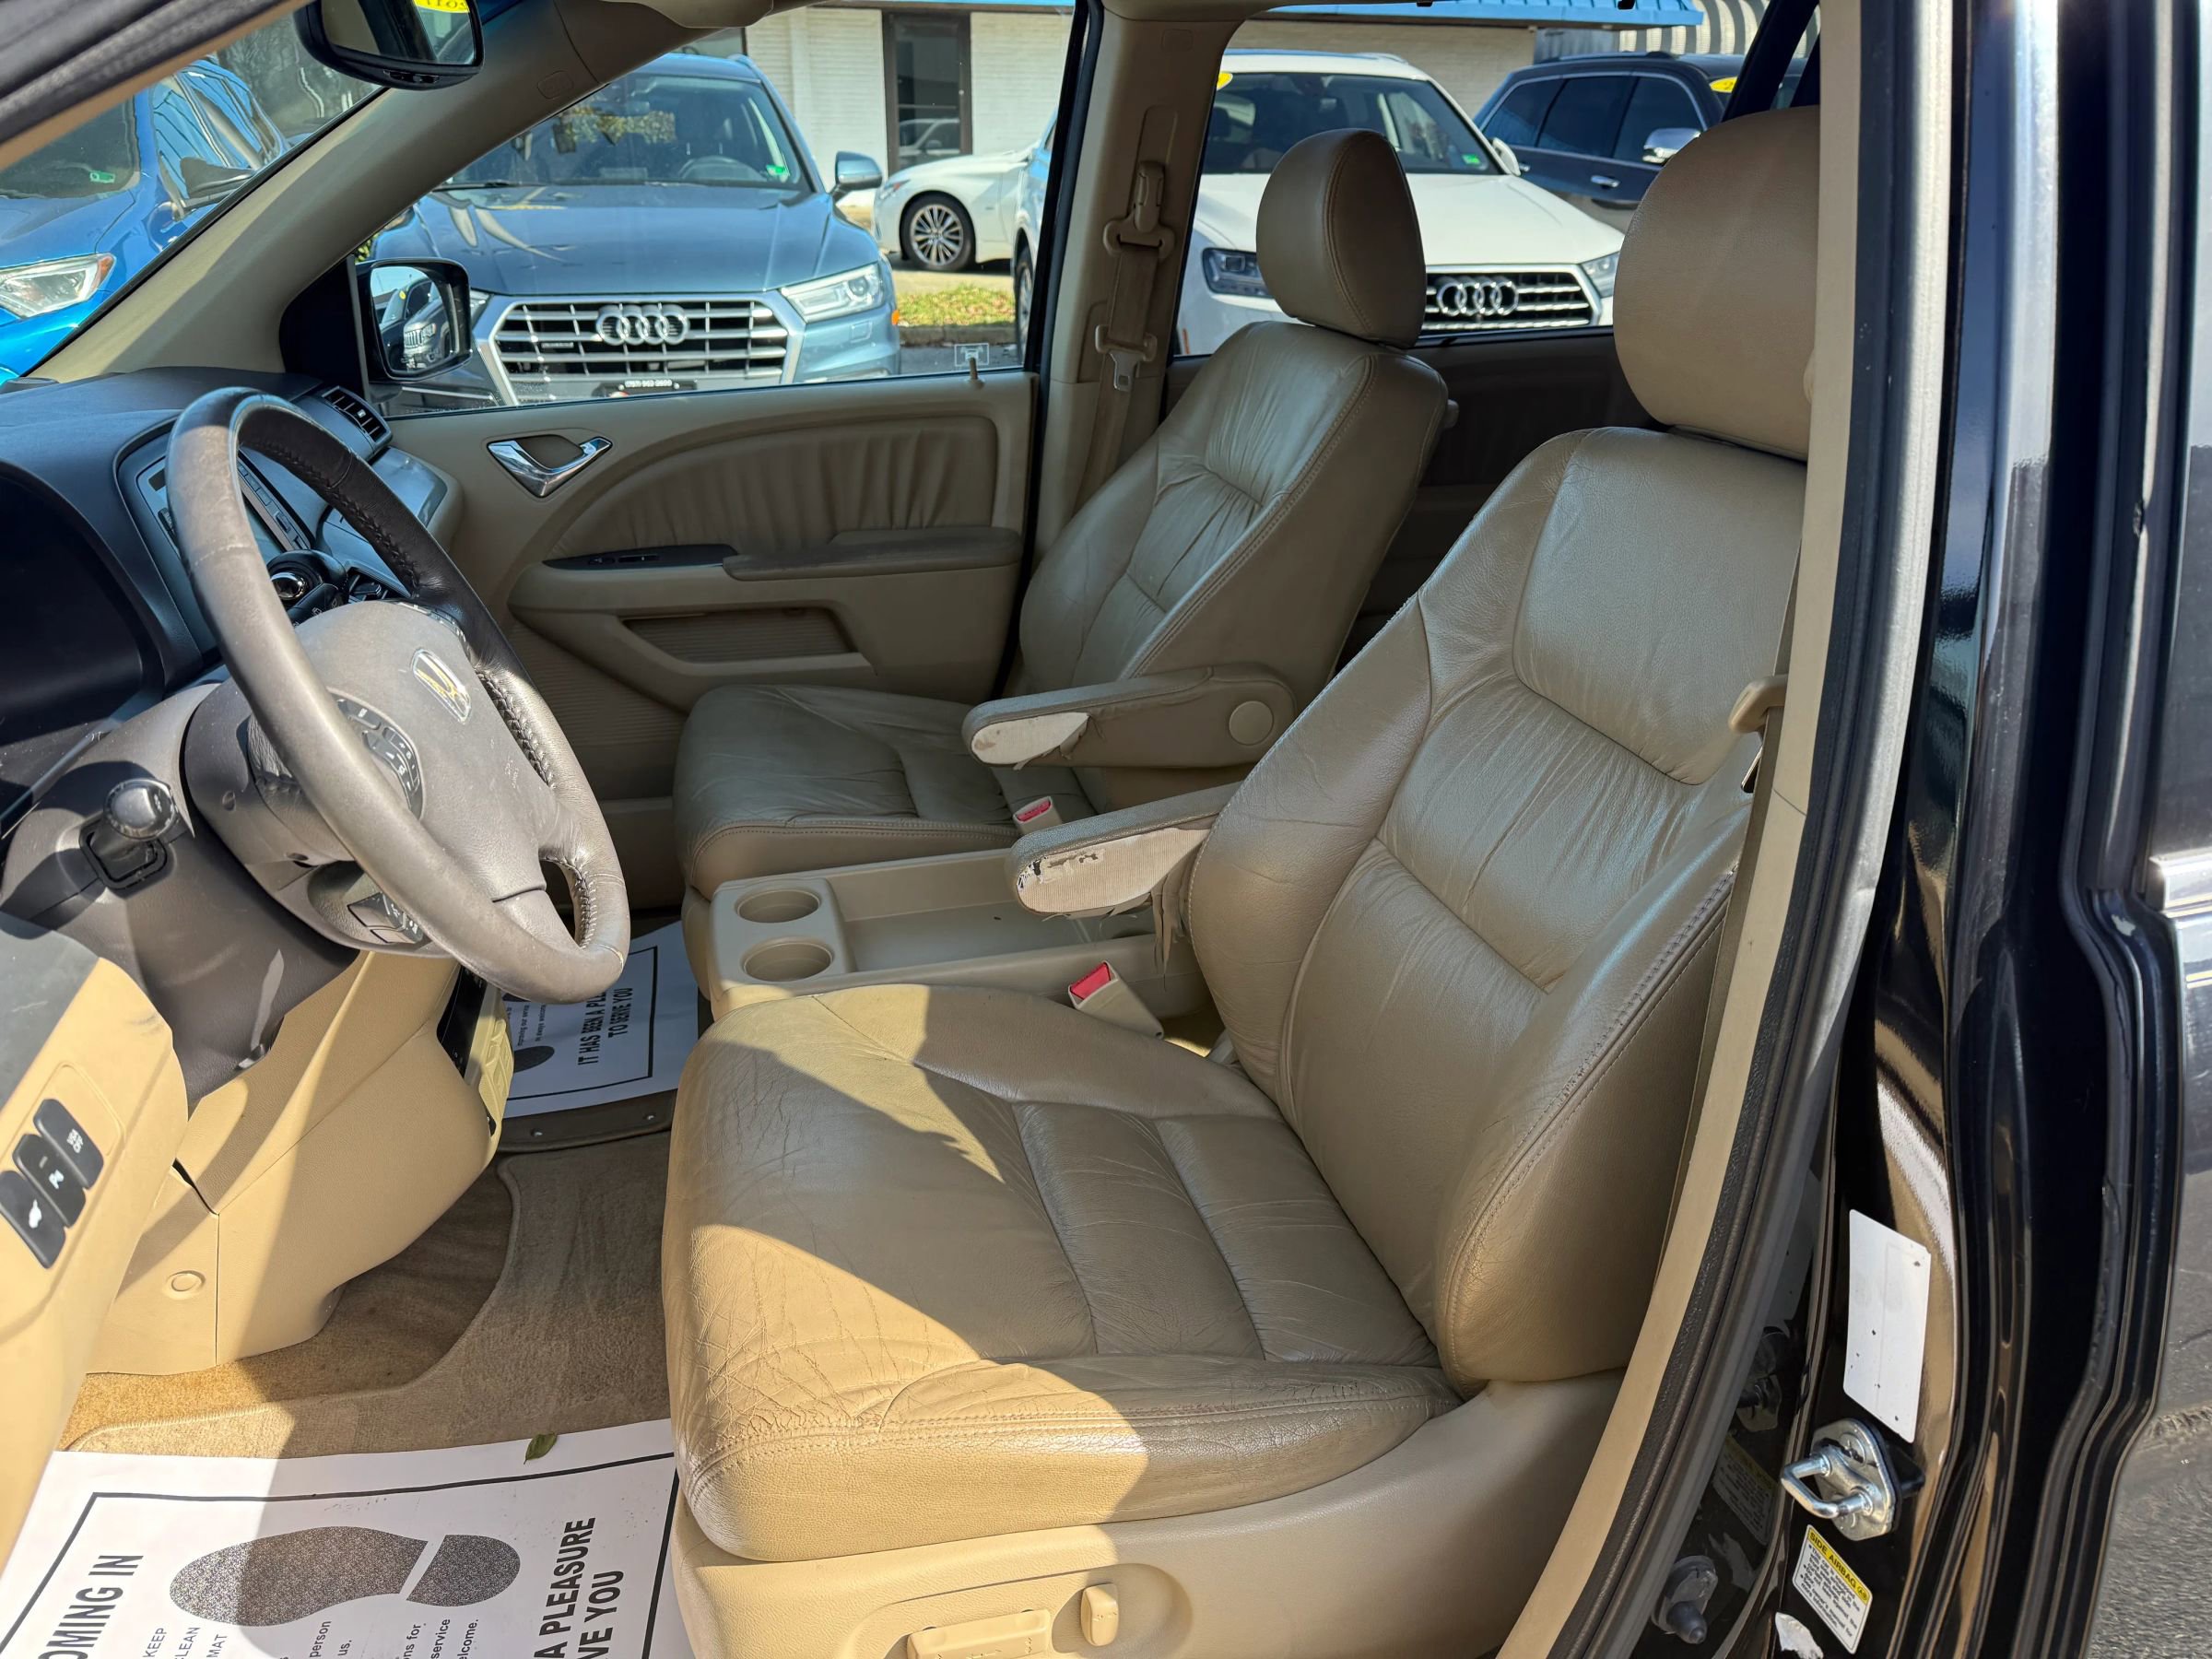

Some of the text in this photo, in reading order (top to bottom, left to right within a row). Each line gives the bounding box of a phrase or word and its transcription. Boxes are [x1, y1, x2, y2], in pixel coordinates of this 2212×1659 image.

[581, 1016, 605, 1033] BEEN
[608, 988, 633, 1038] TO SERVE YOU
[579, 1034, 601, 1053] HAS
[578, 1056, 599, 1065] IT
[88, 1555, 144, 1576] IN
[1810, 1532, 1856, 1589] SIDE AIRBAG
[534, 1517, 596, 1659] A PLEASURE
[584, 1571, 624, 1622] YOU
[143, 1628, 167, 1657] KEEP
[174, 1627, 201, 1659] LEAN
[206, 1634, 228, 1658] MAT
[309, 1620, 332, 1658] person
[406, 1624, 421, 1641] for
[430, 1618, 451, 1659] service
[337, 1640, 352, 1657] us.
